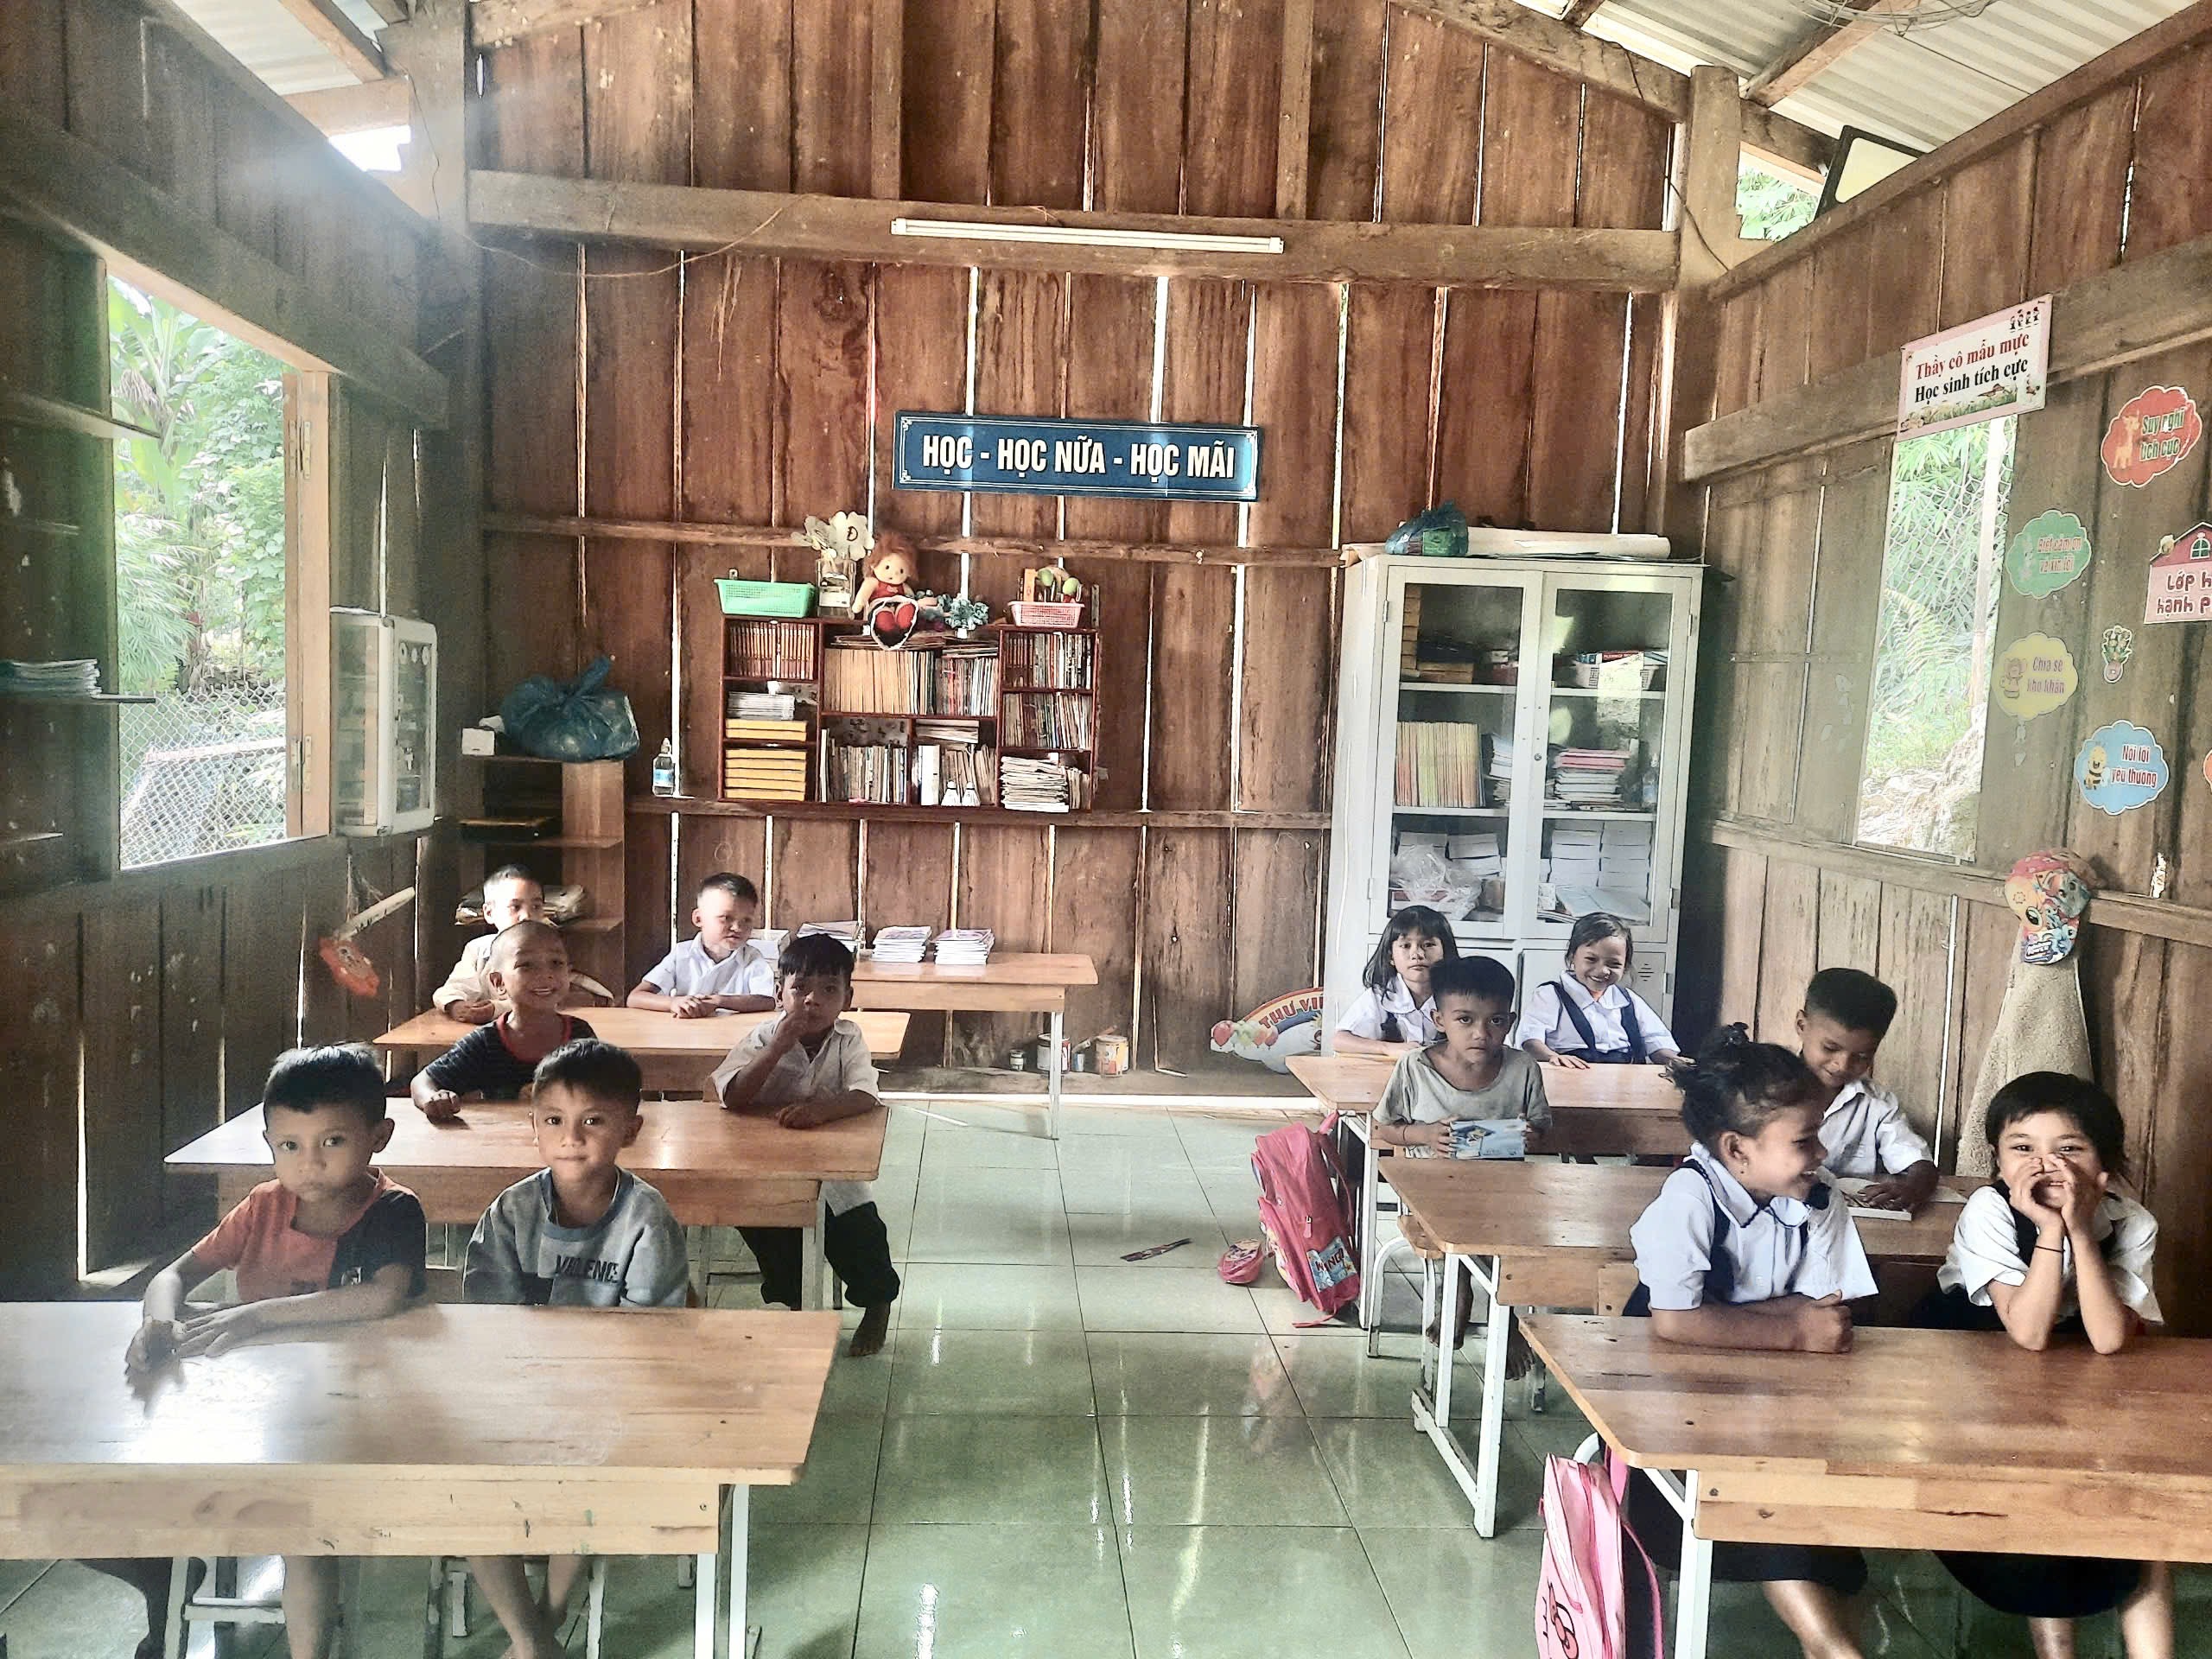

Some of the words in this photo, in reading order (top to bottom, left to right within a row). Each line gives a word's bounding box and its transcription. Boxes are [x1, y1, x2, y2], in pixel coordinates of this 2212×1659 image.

[1916, 354, 1946, 380] Thầy
[1948, 351, 1963, 370] cô
[1967, 339, 1995, 365] mẫu
[1999, 333, 2030, 356] mực
[1914, 385, 1941, 405] Học
[1942, 373, 1970, 395] sinh
[1974, 365, 1999, 385] tích
[2003, 359, 2028, 381] cực
[922, 435, 975, 475] HỌC
[997, 439, 1047, 479] HỌC
[1054, 435, 1107, 474] NỮA
[1129, 442, 1179, 483] HỌC
[1186, 441, 1236, 479] MÃI
[2167, 570, 2196, 592] Lớp
[2157, 596, 2193, 617] hạnh
[2033, 656, 2051, 672] Chia
[1259, 1000, 1297, 1029] THƯ
